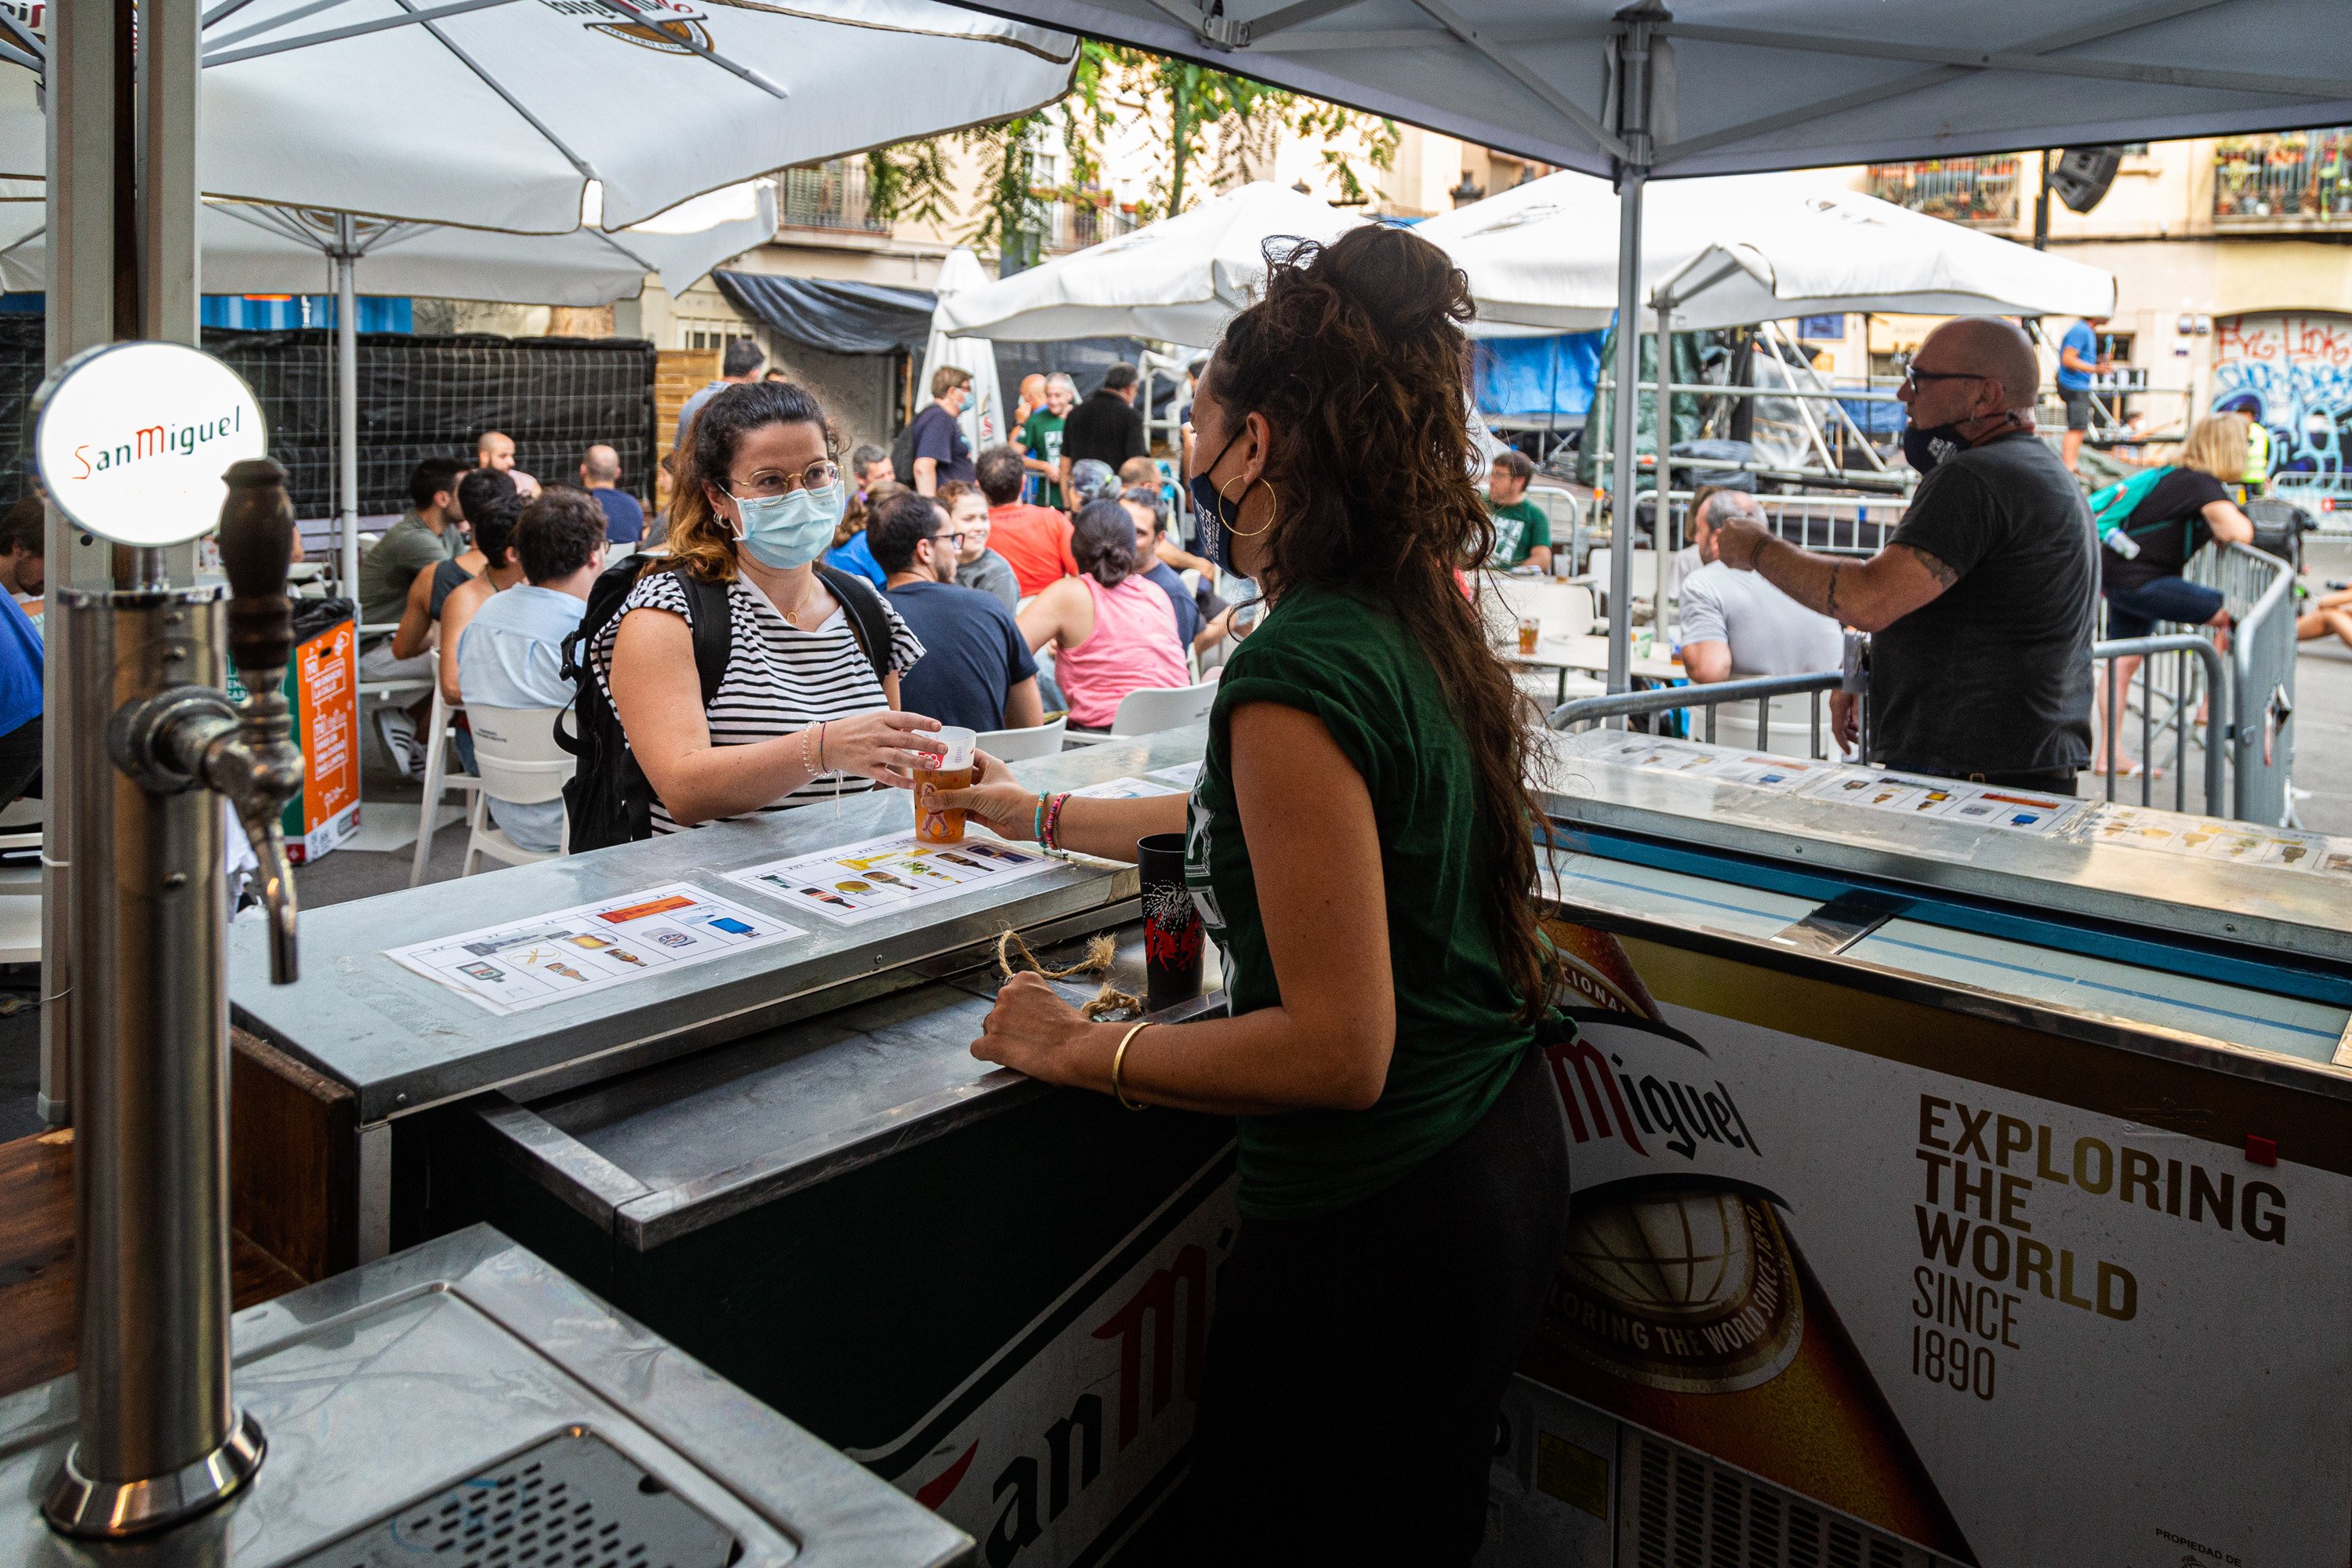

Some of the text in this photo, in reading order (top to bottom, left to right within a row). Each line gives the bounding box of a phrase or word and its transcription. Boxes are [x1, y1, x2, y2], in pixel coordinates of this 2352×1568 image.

[1915, 1149, 2033, 1233] THE
[1919, 1093, 2287, 1246] EXPLORING
[1655, 1325, 1704, 1356] THE
[1703, 1305, 1768, 1355] WORLD
[1753, 1254, 1779, 1318] SINCE
[1915, 1204, 2138, 1322] WORLD
[1912, 1265, 2022, 1350] SINCE
[1912, 1326, 1996, 1402] 1890
[2156, 1528, 2242, 1568] PROPIEDAD DE
